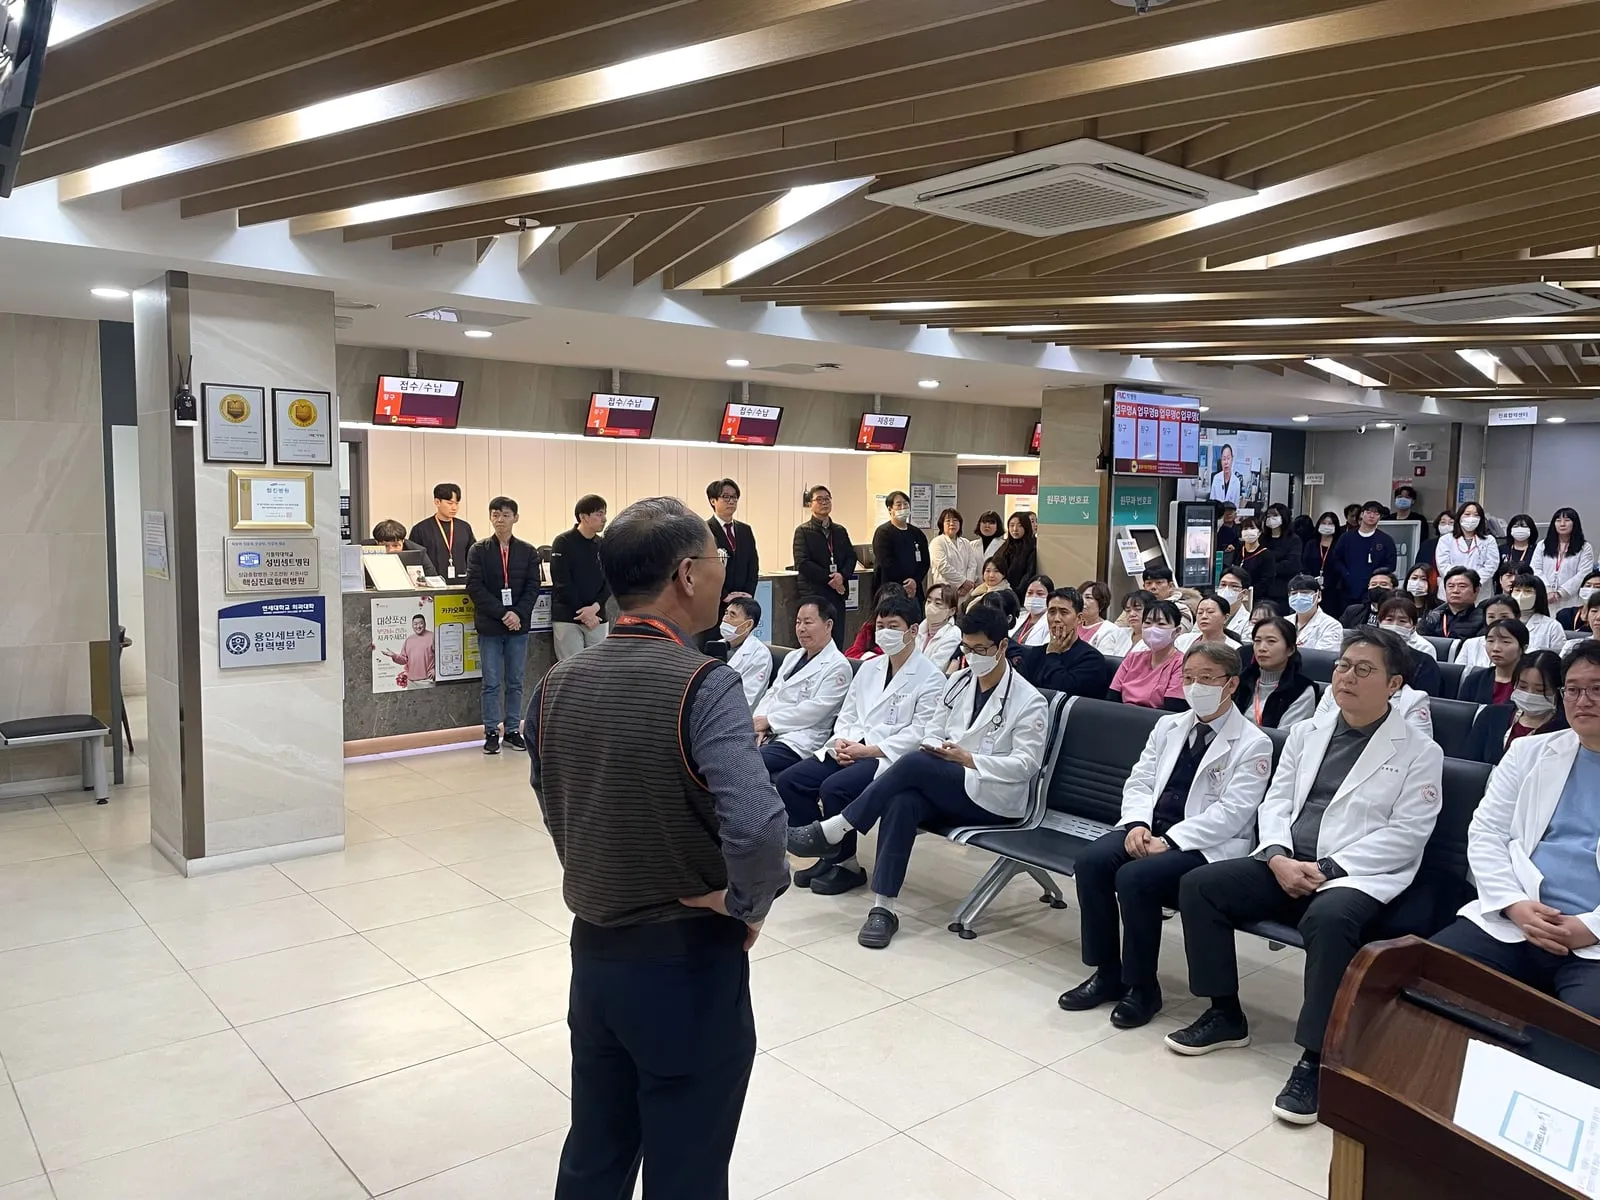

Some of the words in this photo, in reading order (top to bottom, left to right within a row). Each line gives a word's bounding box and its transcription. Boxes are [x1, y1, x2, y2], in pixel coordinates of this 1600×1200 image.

[400, 380, 442, 393] 접수/수납
[608, 397, 642, 408] 접수/수납
[384, 405, 391, 415] 1
[740, 407, 769, 417] 접수/수납
[1138, 406, 1159, 418] 업무명B
[1160, 408, 1180, 420] 업무명C
[593, 419, 600, 428] 1
[727, 427, 733, 435] 1
[863, 435, 868, 443] 1
[1046, 495, 1067, 505] 원무과
[1068, 495, 1090, 505] 번호표
[1120, 496, 1136, 506] 원무과
[1137, 496, 1152, 505] 번호표
[265, 558, 310, 567] 성빈센트병원
[242, 577, 305, 587] 핵심진료협력병원
[262, 604, 290, 612] 연세대학교
[377, 615, 407, 626] 대상포진
[254, 629, 315, 642] 용인세브란스
[254, 640, 296, 652] 협력병원
